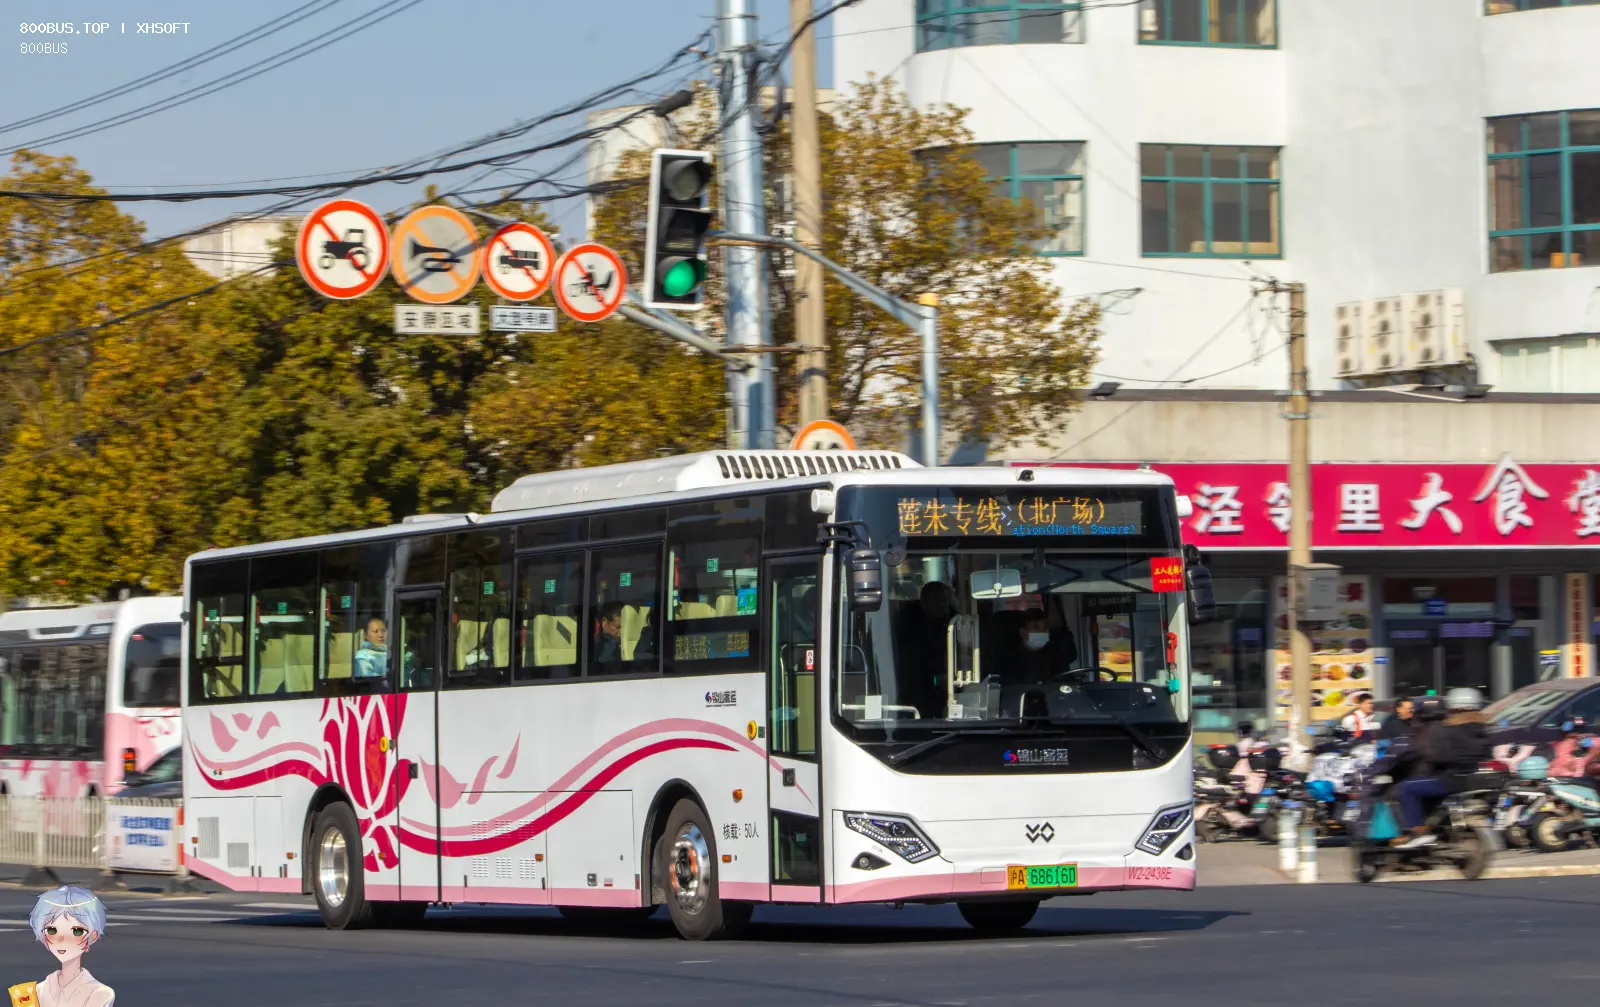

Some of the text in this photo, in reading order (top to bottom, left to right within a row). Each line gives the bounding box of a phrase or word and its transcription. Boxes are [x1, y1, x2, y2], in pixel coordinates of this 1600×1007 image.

[898, 497, 1002, 536] 莲朱专线
[1091, 524, 1136, 535] Square)
[1127, 866, 1172, 881] W2-2438E
